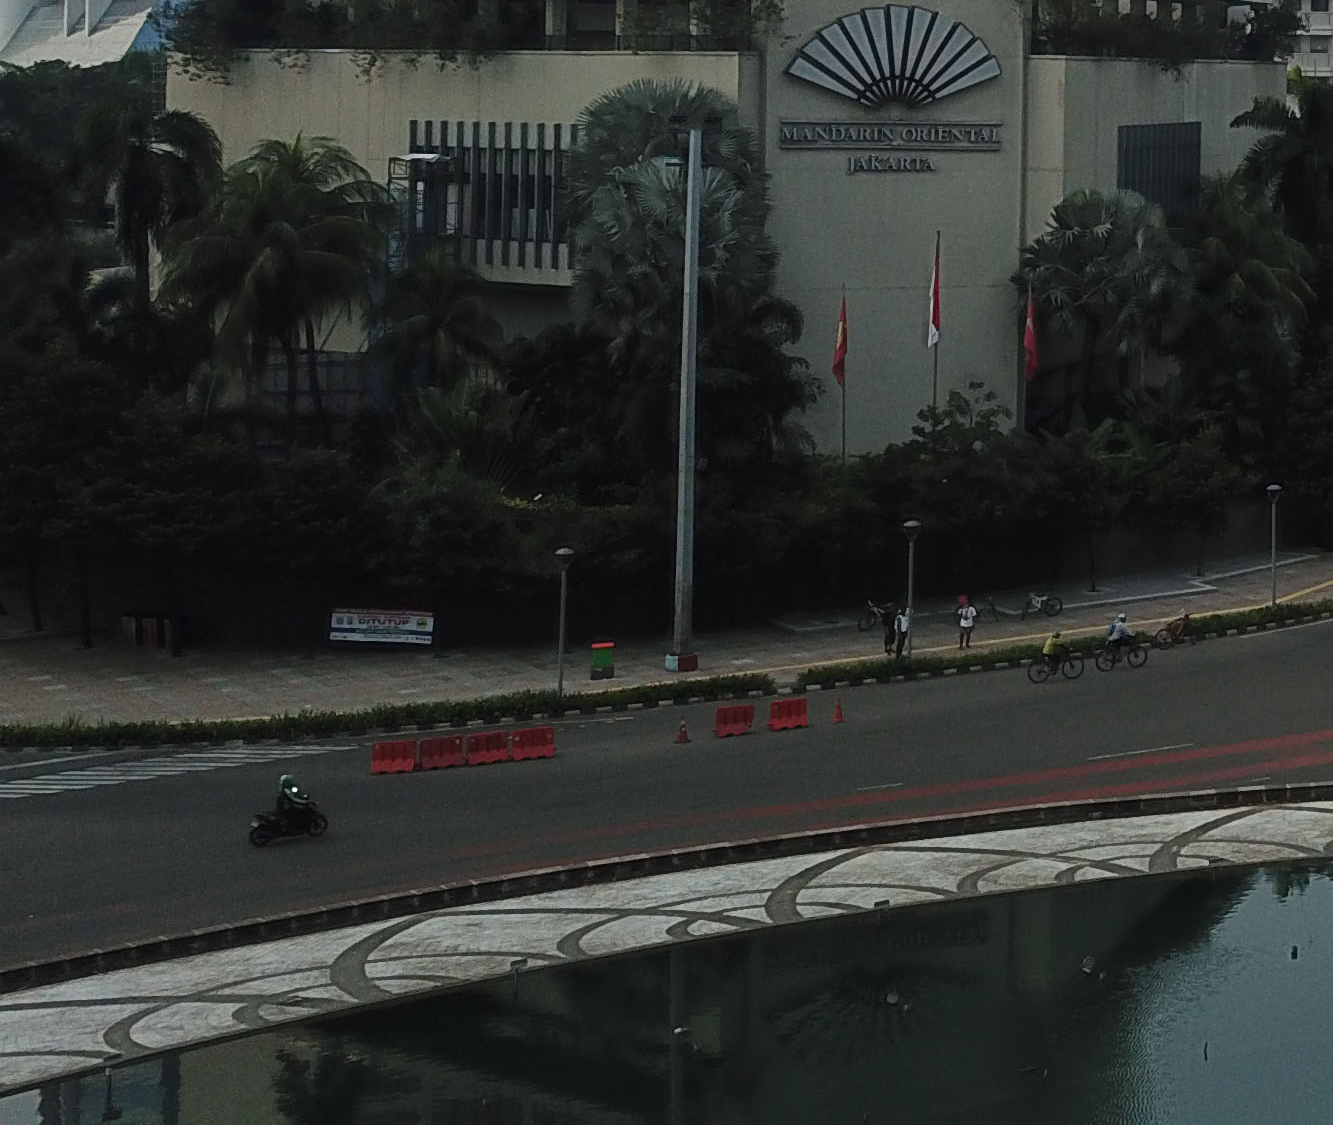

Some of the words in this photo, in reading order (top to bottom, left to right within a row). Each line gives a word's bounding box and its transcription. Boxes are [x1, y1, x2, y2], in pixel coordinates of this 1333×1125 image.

[781, 126, 894, 143] MANDARIN
[901, 126, 1002, 143] ORIENTAL
[848, 154, 935, 175] JAKARTA
[358, 618, 410, 626] DITUTUP
